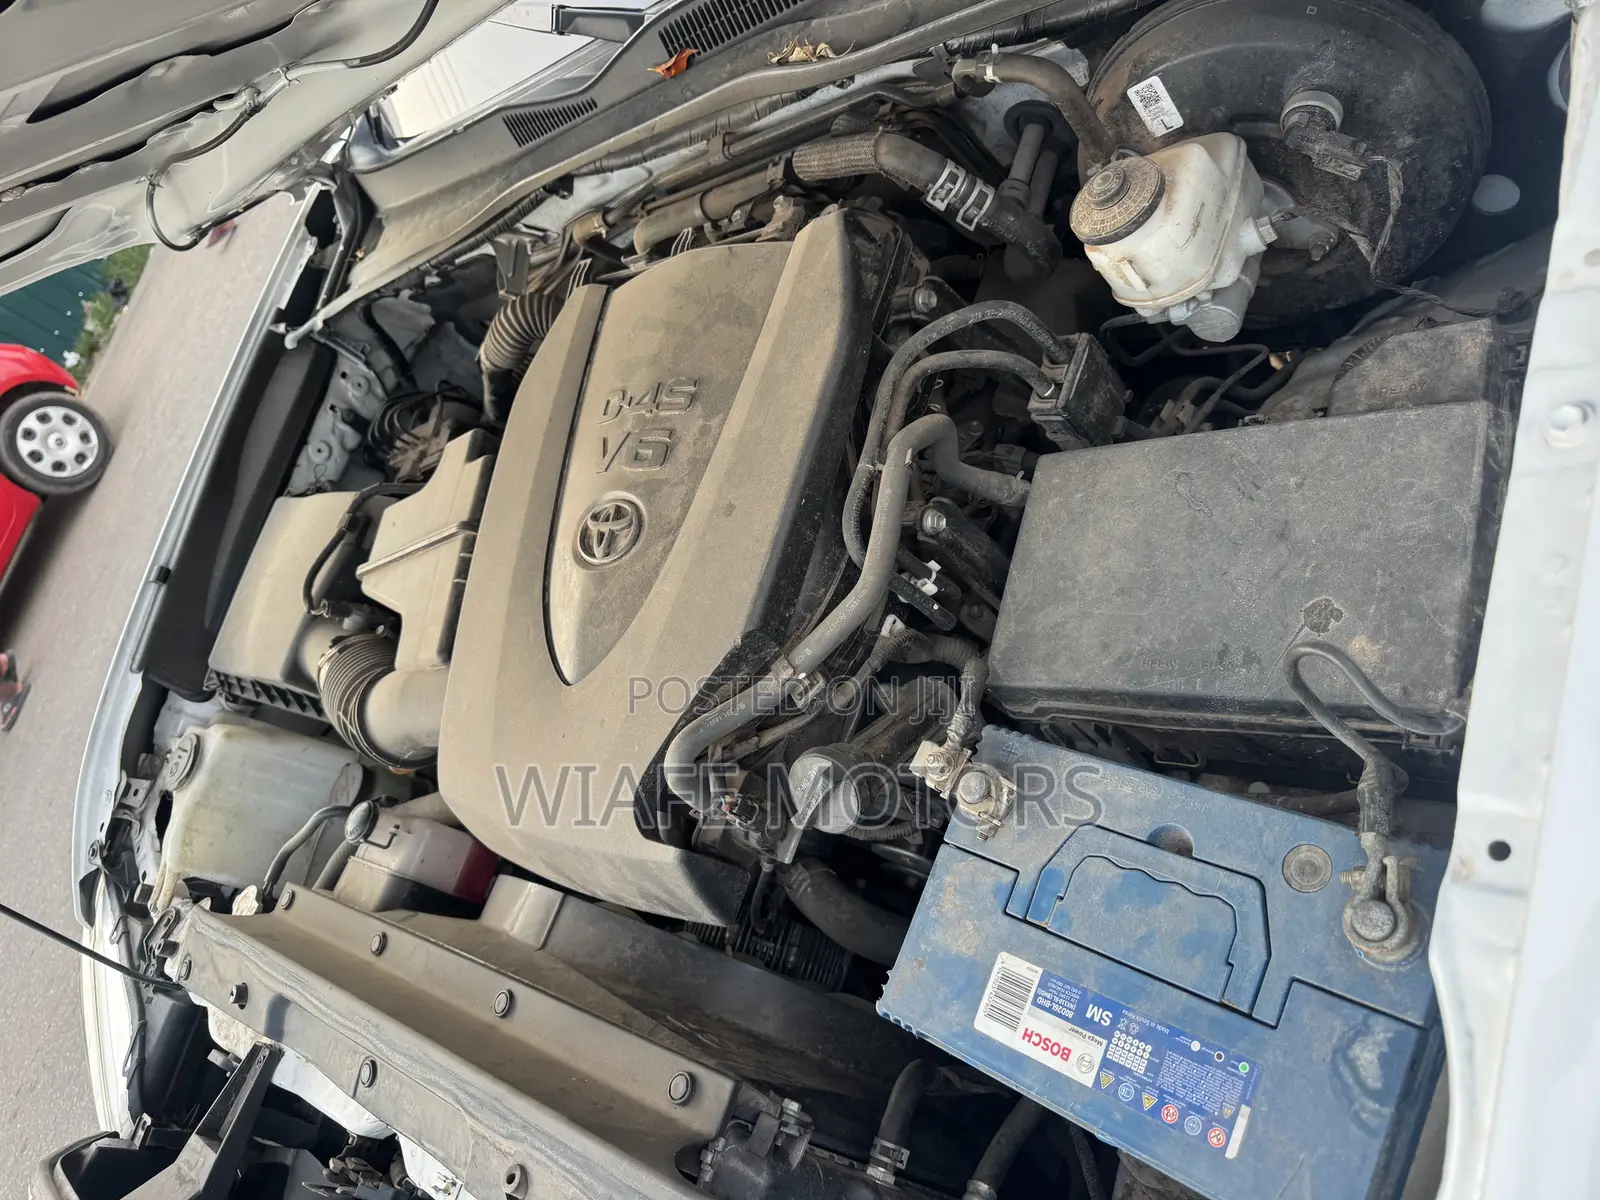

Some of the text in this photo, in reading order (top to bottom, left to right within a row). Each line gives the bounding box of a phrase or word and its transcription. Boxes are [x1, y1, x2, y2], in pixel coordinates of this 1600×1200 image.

[596, 428, 682, 475] V6
[1036, 996, 1074, 1019] 80D26L-BHD
[1085, 1003, 1113, 1027] SM
[1136, 1015, 1151, 1026] South
[1156, 1023, 1171, 1035] Made
[1022, 1028, 1072, 1062] BOSCH
[1068, 1027, 1104, 1047] Mega Power
